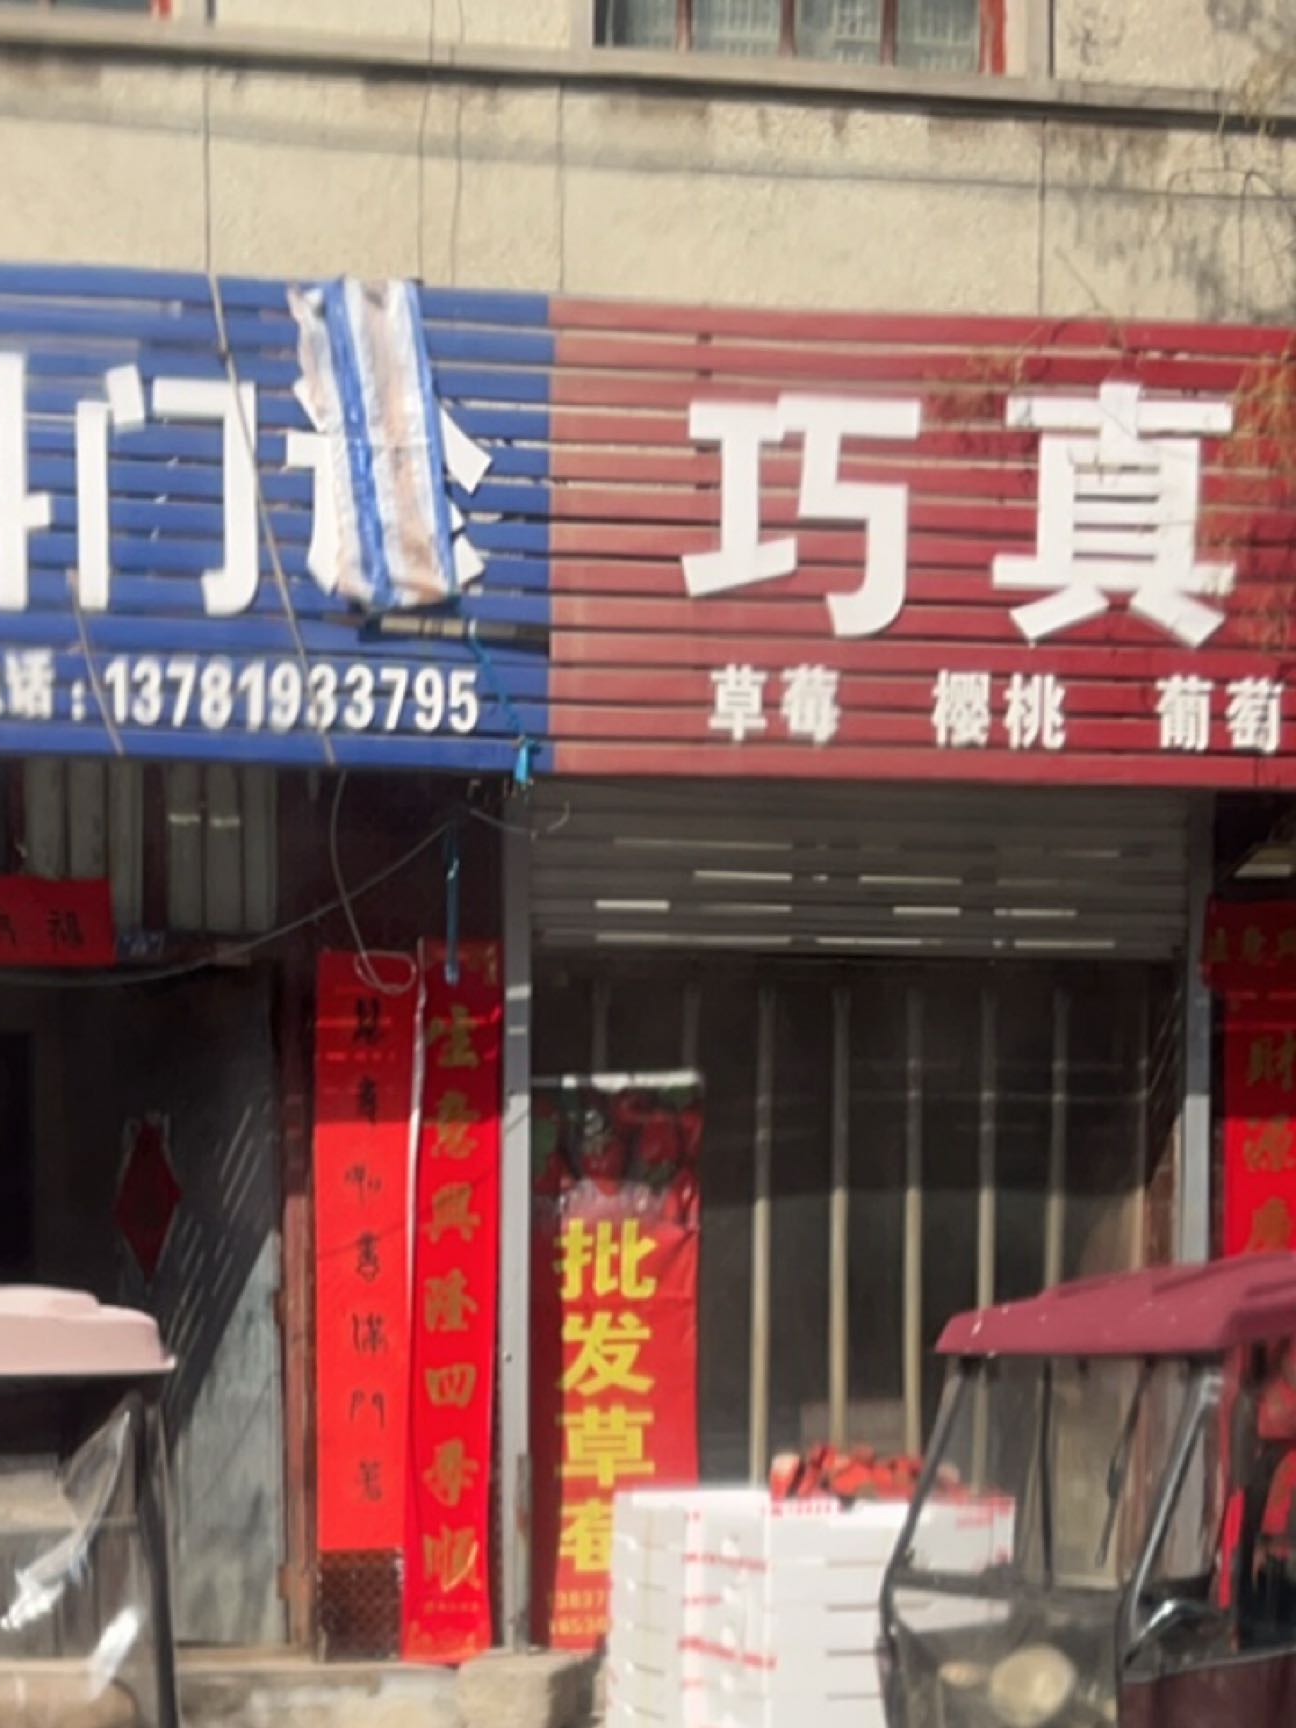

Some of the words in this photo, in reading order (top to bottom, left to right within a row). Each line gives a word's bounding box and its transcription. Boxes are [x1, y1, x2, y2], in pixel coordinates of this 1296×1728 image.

[681, 380, 1237, 648] 巧真
[708, 662, 842, 745] 草莓
[931, 668, 1065, 750] 樱桃
[1154, 672, 1283, 754] 葡萄
